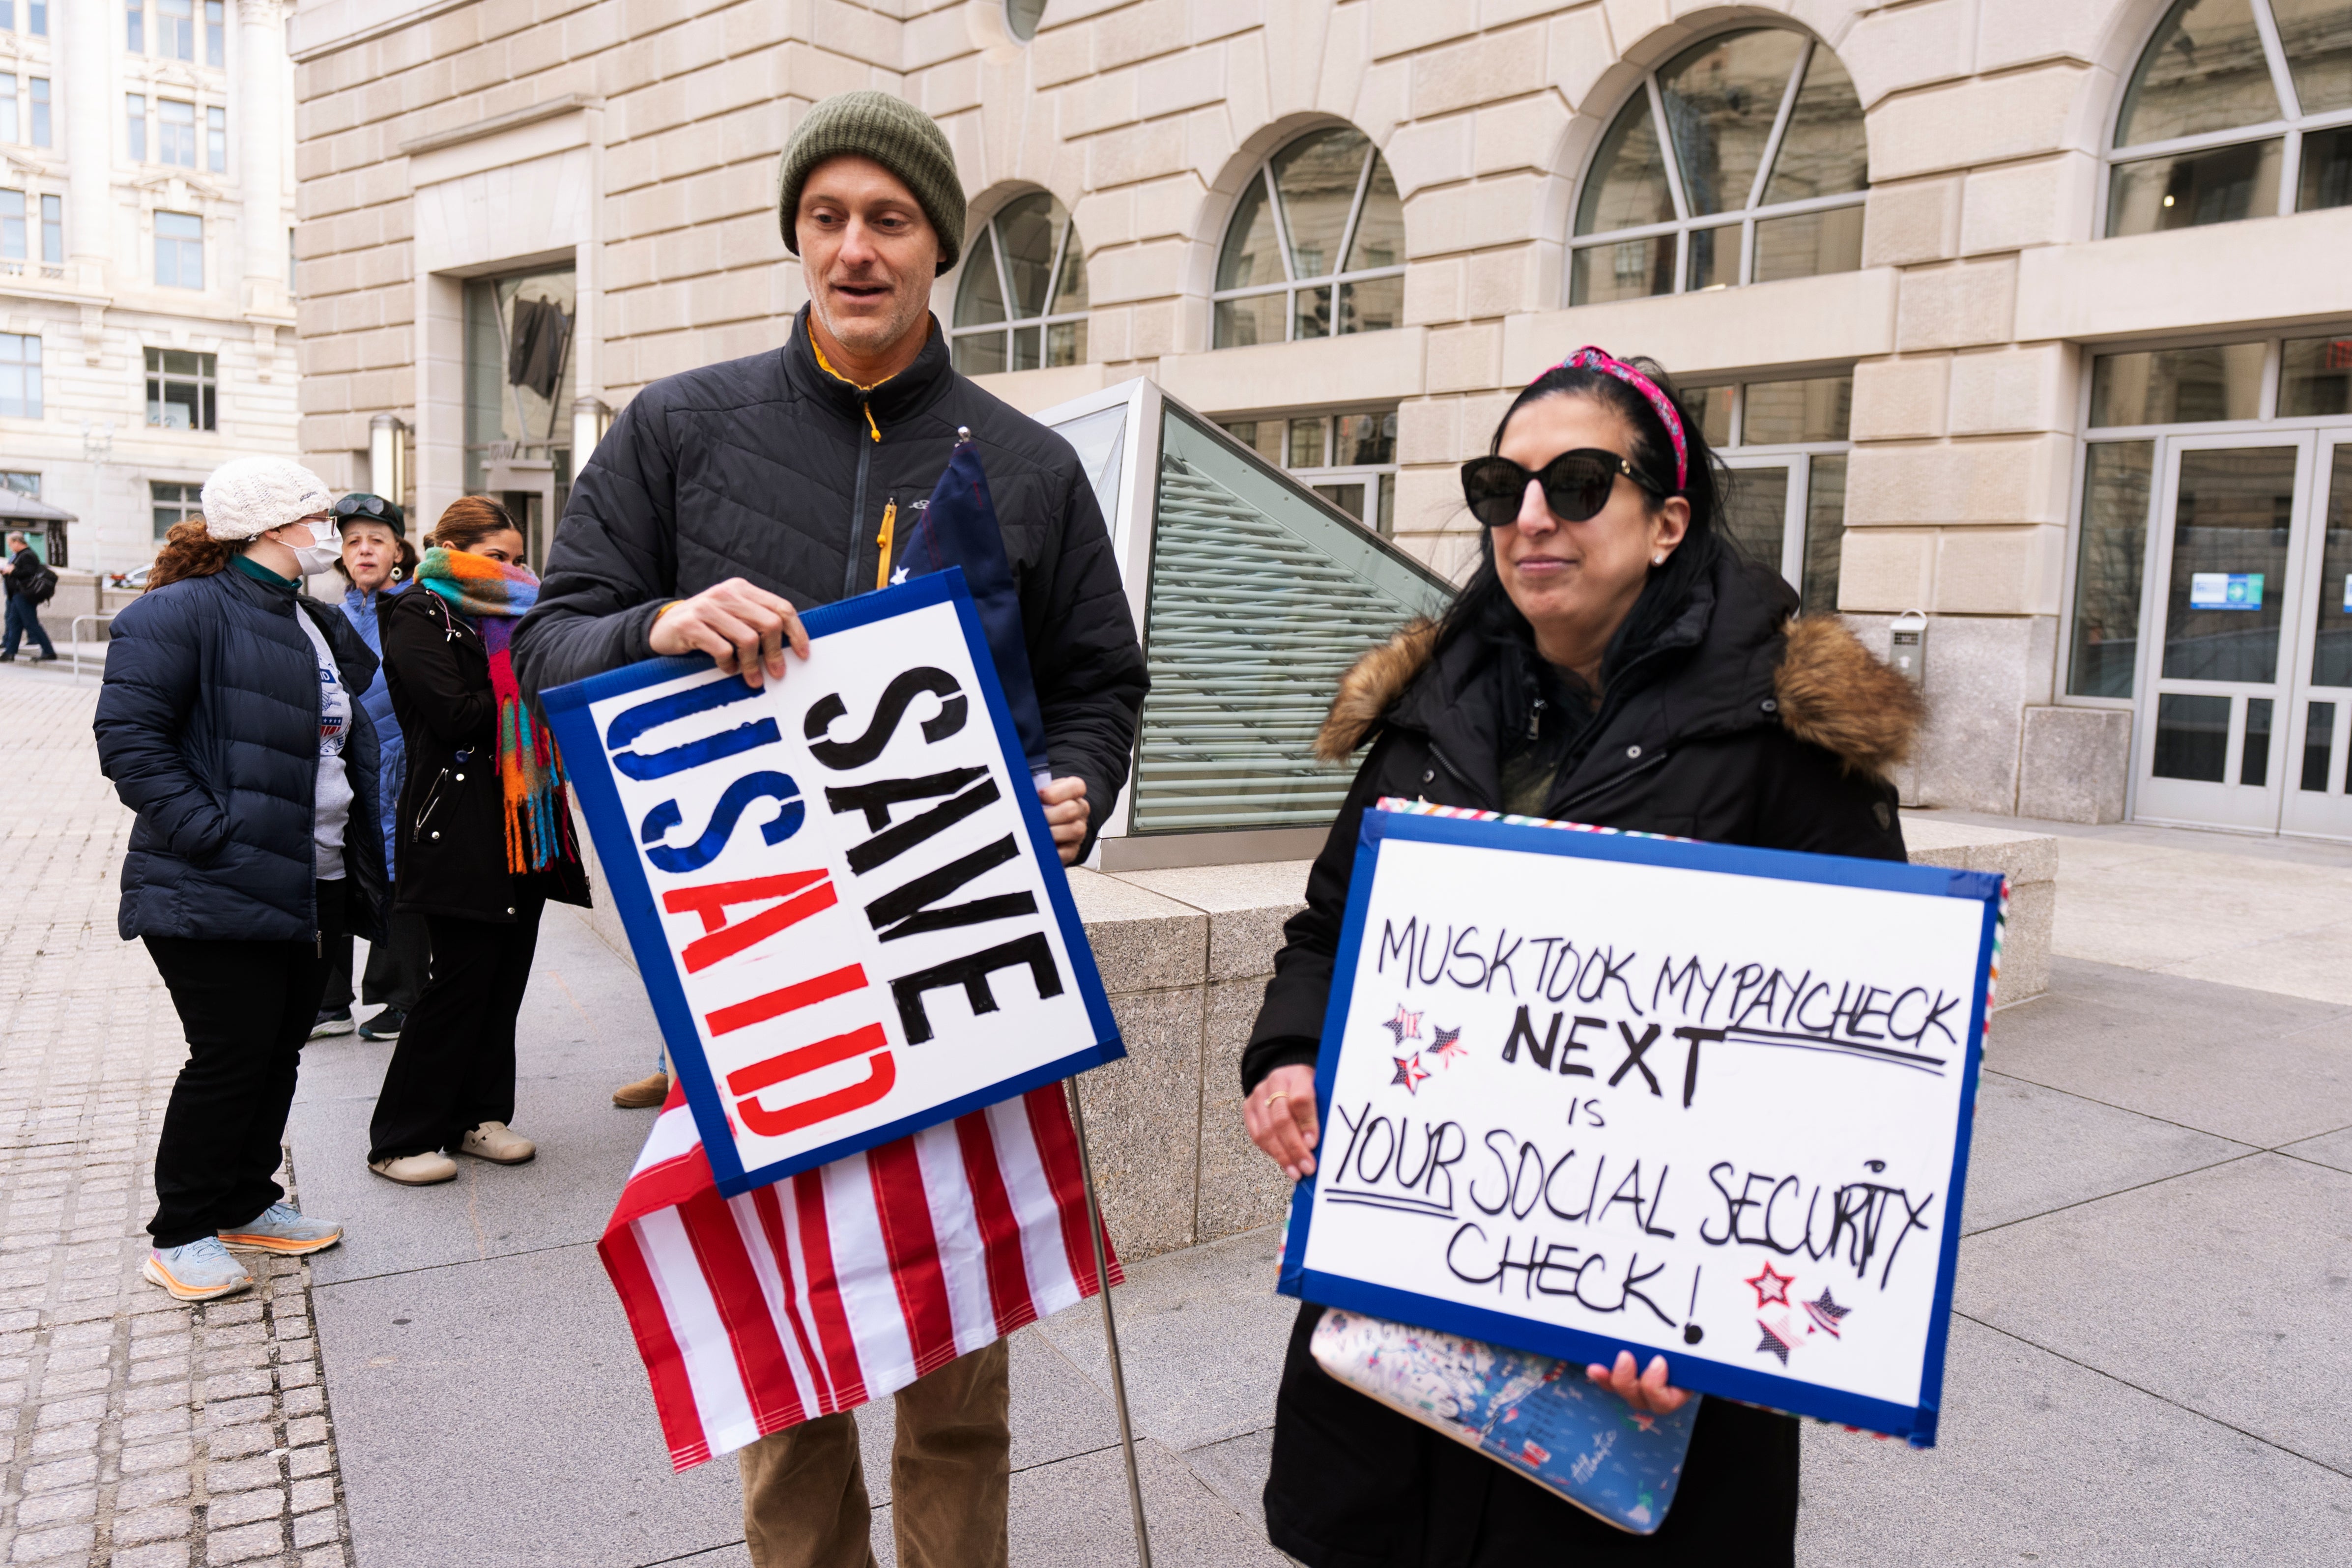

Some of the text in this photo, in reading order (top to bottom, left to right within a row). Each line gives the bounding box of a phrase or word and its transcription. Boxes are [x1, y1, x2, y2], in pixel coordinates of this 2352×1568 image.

[607, 674, 896, 1137] USAID
[804, 667, 1064, 1046] SAVE
[1379, 916, 1959, 1047] MUSK TOOK MY PAYCHECK
[1502, 1004, 1725, 1109] NEXT
[1568, 1098, 1606, 1127] IS
[1336, 1102, 1933, 1290] YOUR SOCIAL SECURITY
[1336, 1321, 1444, 1353] VIRGI
[1447, 1223, 1703, 1345] CHECK!
